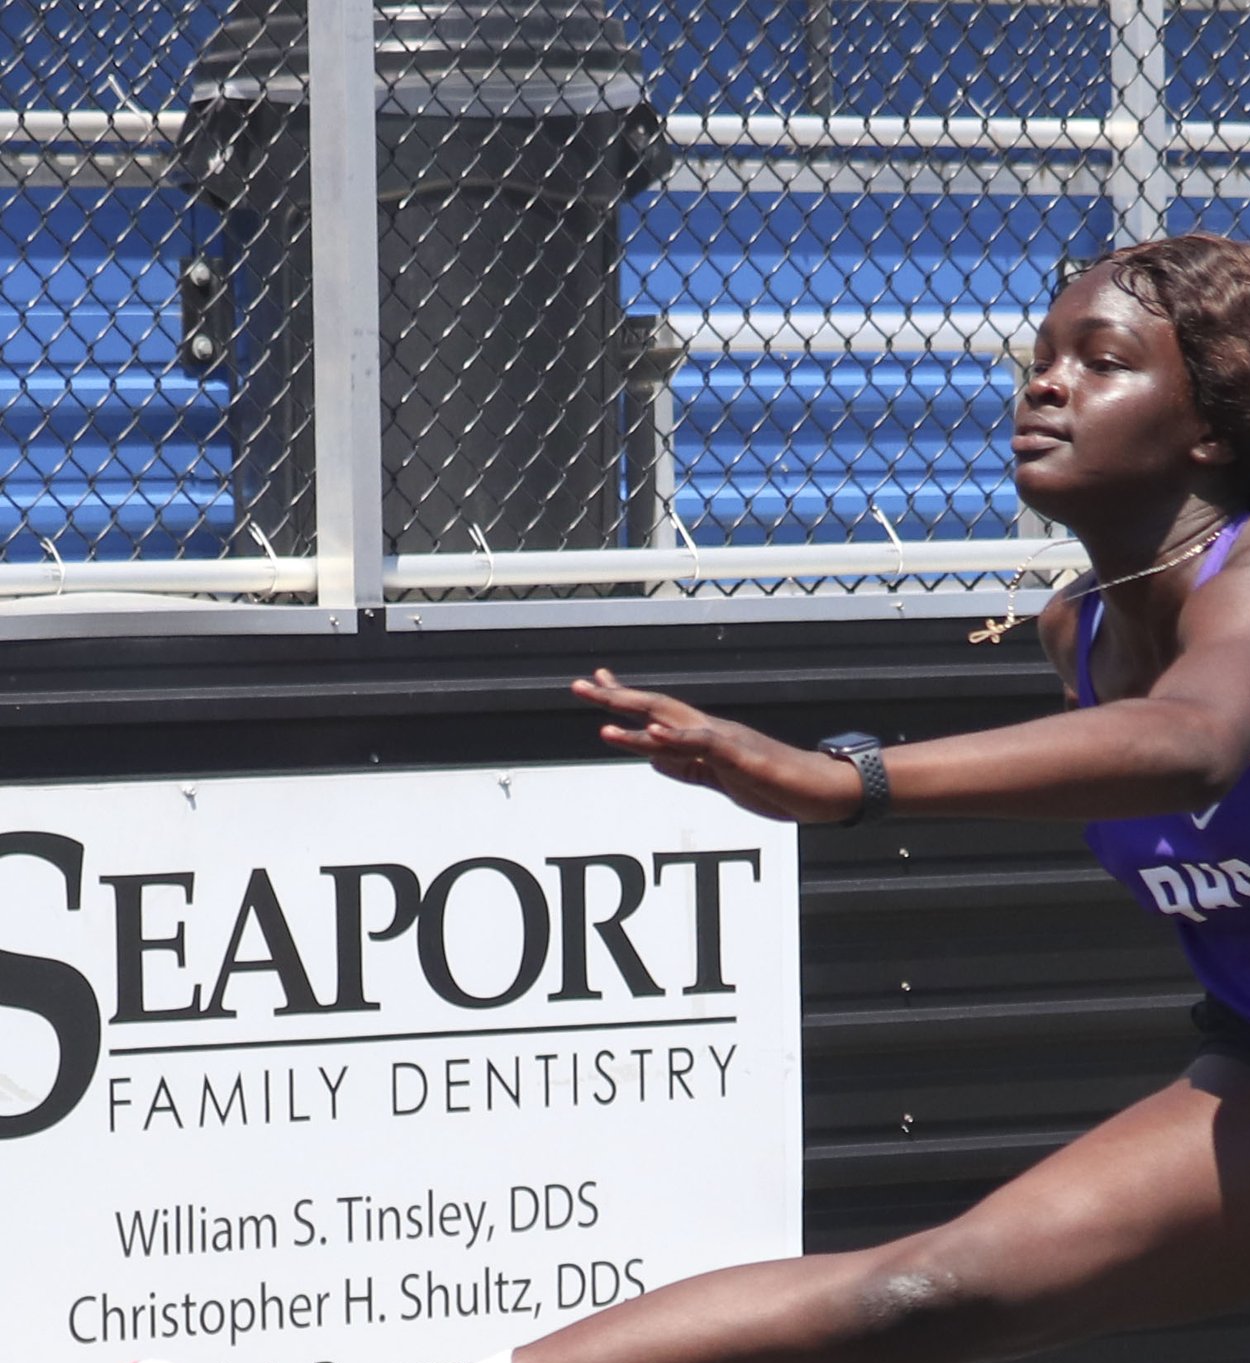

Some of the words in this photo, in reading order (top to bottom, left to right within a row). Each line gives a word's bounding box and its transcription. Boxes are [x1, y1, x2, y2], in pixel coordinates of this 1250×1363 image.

[109, 1065, 348, 1133] FAMILY
[392, 1044, 737, 1116] DENTISTRY
[115, 1204, 277, 1258] William
[293, 1199, 327, 1247] S.
[336, 1189, 495, 1250] Tinsley,
[510, 1181, 599, 1233] DDS
[68, 1281, 331, 1346] Christopher
[345, 1276, 387, 1325] H.
[400, 1266, 542, 1321] Shultz,
[557, 1258, 646, 1310] DDS
